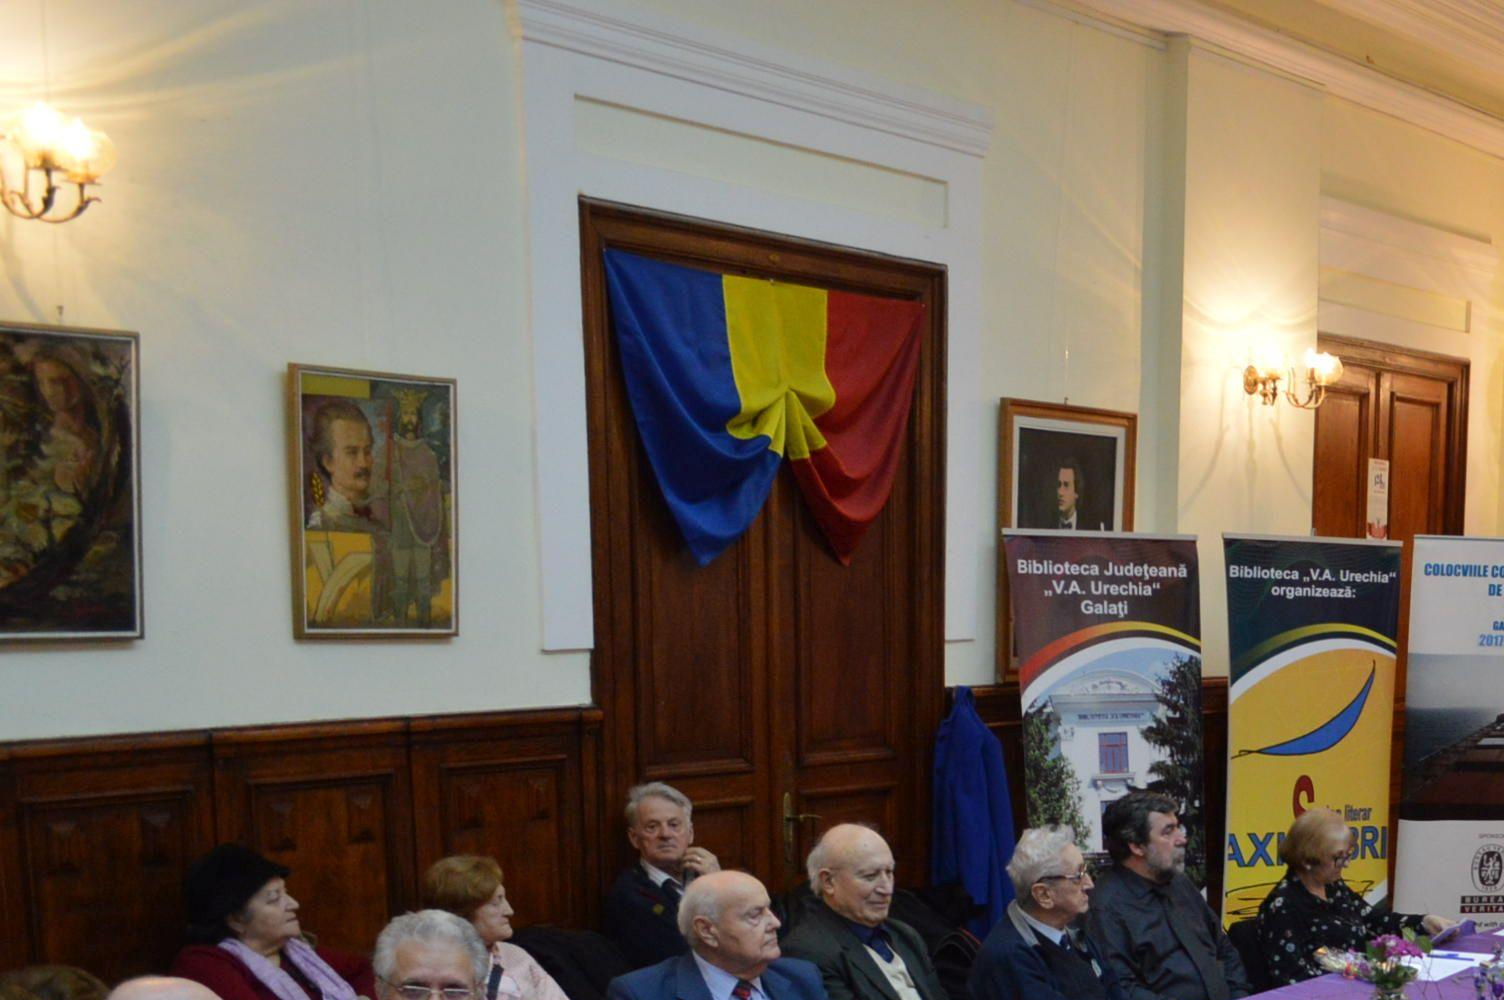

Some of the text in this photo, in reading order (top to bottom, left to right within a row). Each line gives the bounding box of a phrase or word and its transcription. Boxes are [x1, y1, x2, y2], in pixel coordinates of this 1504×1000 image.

[1017, 559, 1099, 576] Biblioteca
[1229, 565, 1299, 580] Biblioteca
[1424, 563, 1489, 578] COLOCVIILE
[1271, 584, 1357, 599] organizează:
[1488, 584, 1502, 597] DE
